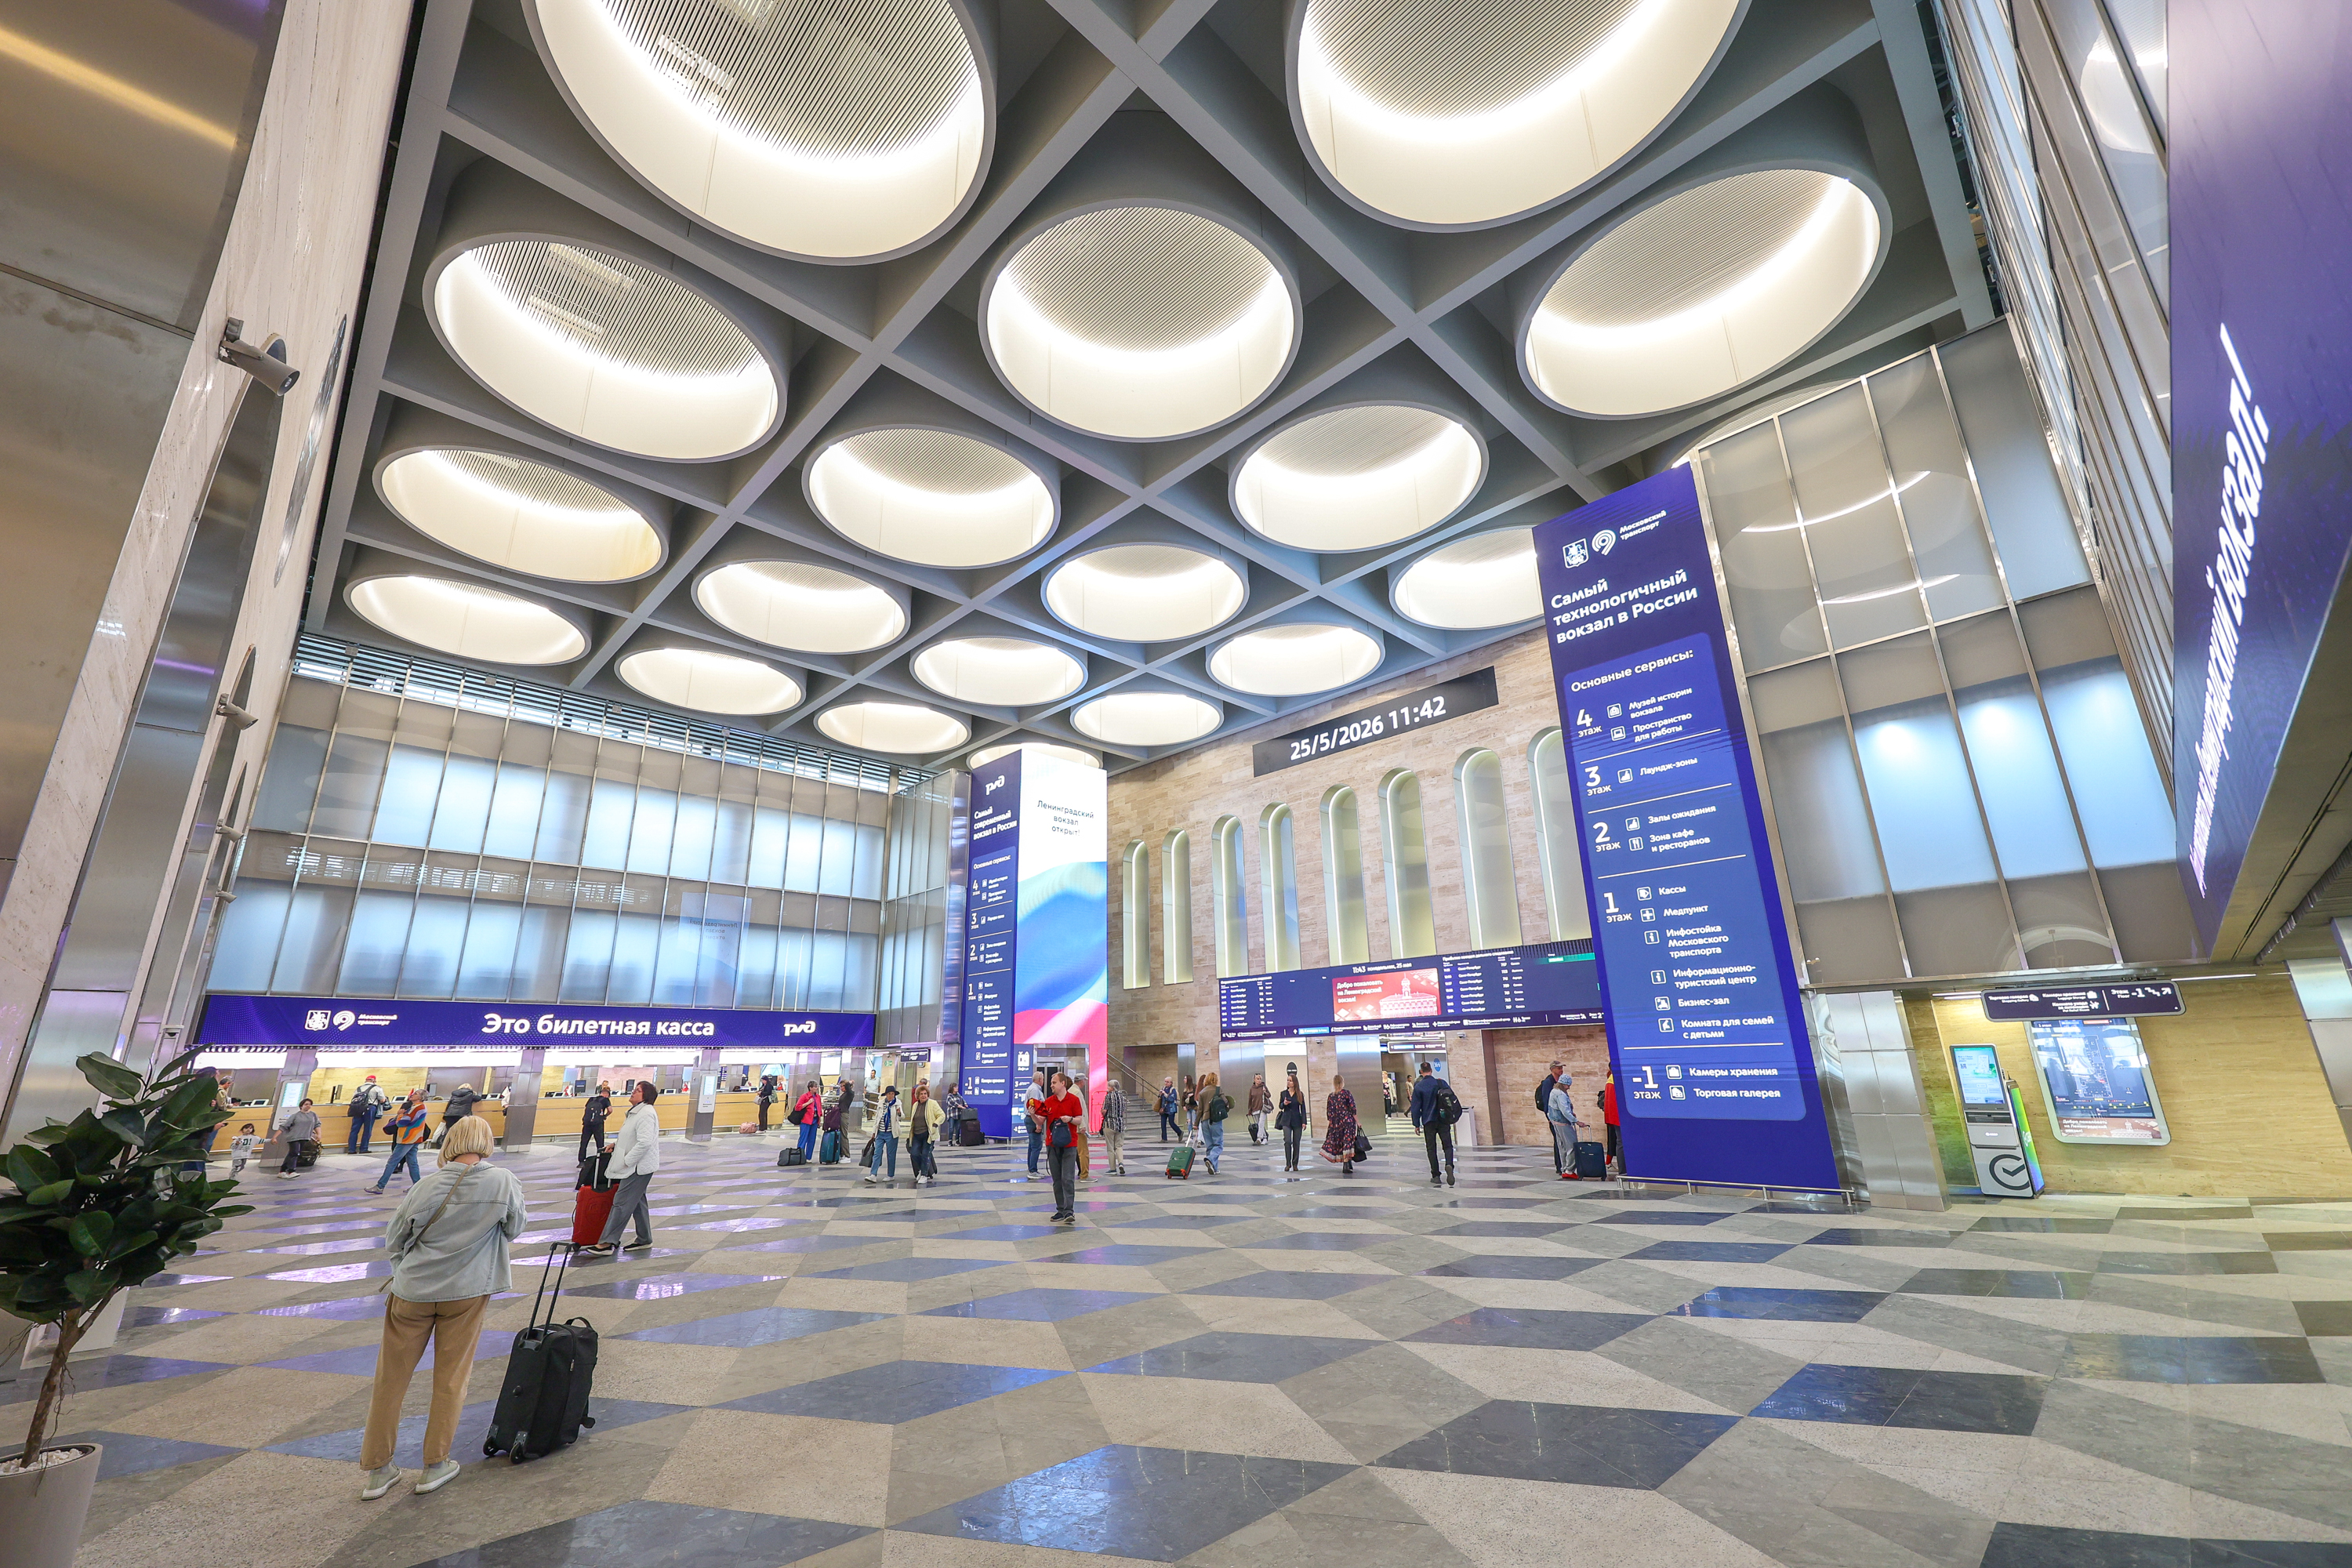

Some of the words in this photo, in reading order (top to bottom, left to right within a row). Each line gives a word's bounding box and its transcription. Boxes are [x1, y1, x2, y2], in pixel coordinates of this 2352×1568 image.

[1620, 510, 1667, 534] Московский
[1621, 521, 1659, 540] транспорт
[2195, 565, 2238, 802] Ленинградский
[2217, 322, 2269, 626] вокзал!
[1551, 579, 1608, 608] Самый
[1553, 569, 1687, 626] технологичный
[1556, 615, 1614, 644] вокзал
[1618, 612, 1628, 623] в
[1632, 588, 1698, 619] России
[1571, 668, 1632, 691] Основные
[1635, 649, 1694, 674] сервисы:
[1629, 696, 1656, 710] Музей
[1657, 687, 1693, 702] истории
[1576, 709, 1593, 727] 4
[1631, 705, 1663, 718] вокзала
[1290, 715, 1384, 760] 25/5/2026
[1388, 695, 1446, 729] 11:42
[1633, 713, 1693, 732] Пространство
[1577, 724, 1602, 737] этаж
[1634, 732, 1650, 742] для
[1651, 724, 1682, 739] работы
[1640, 757, 1698, 776] Лаундж-зоны
[1585, 766, 1601, 786] 3
[1587, 784, 1612, 797] этаж
[975, 806, 993, 819] Самый
[1037, 800, 1094, 818] Ленинградский
[1648, 814, 1670, 824] Залы
[1671, 805, 1716, 820] ожидания
[974, 810, 1011, 829] современный
[1054, 815, 1079, 826] вокзал
[974, 829, 992, 840] вокзал
[997, 820, 1017, 832] России
[1051, 826, 1080, 836] открыт!
[1593, 822, 1610, 843] 2
[1650, 832, 1671, 843] Зона
[1672, 828, 1694, 839] кафе
[1595, 841, 1621, 853] этаж
[1657, 837, 1711, 853] ресторанов
[972, 880, 978, 891] 4
[1659, 885, 1686, 895] Кассы
[1603, 892, 1619, 913] 1
[1606, 912, 1632, 924] этаж
[1664, 905, 1708, 917] Медпункт
[971, 913, 977, 924] 3
[1666, 925, 1722, 938] Инфостойка
[1668, 935, 1729, 947] Московского
[970, 945, 975, 956] 2
[1669, 946, 1722, 959] транспорта
[1673, 964, 1756, 978] Информационно-
[1675, 976, 1726, 989] туристский
[1728, 975, 1757, 985] центр
[968, 984, 973, 995] 1
[2132, 988, 2145, 997] -1
[1678, 996, 1730, 1007] Бизнес-зал
[481, 1013, 530, 1033] Это
[536, 1014, 650, 1035] билетная
[655, 1020, 715, 1036] касса
[1681, 1019, 1722, 1029] Комната
[1723, 1018, 1740, 1027] для
[1742, 1015, 1774, 1025] семей
[1690, 1029, 1724, 1040] детьми
[1632, 1065, 1659, 1089] -1
[1690, 1068, 1728, 1077] Камеры
[1730, 1067, 1777, 1077] хранения
[965, 1077, 972, 1089] -1
[1634, 1090, 1661, 1099] этаж
[1694, 1088, 1737, 1098] Торговая
[1740, 1089, 1780, 1098] галерея
